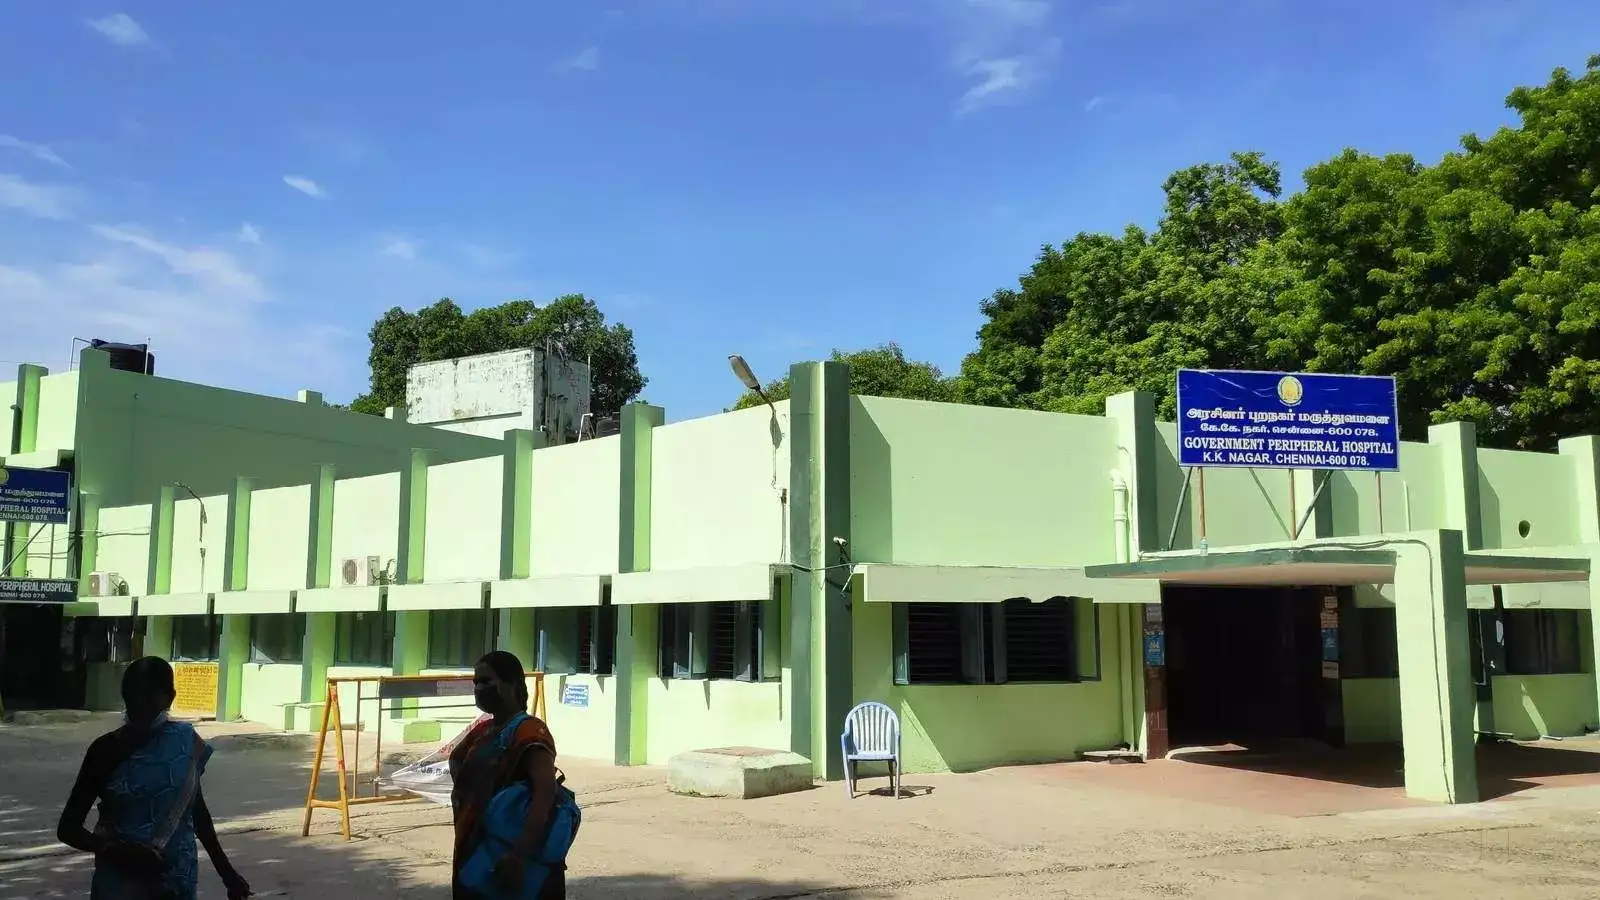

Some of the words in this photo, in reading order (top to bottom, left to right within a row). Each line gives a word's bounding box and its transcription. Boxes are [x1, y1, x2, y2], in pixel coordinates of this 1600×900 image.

[1186, 407, 1246, 421] அரசினர்
[1248, 408, 1296, 423] புறநகர்
[1298, 409, 1390, 426] மருத்துவமனை
[1200, 422, 1241, 432] கே.கே.
[1272, 425, 1352, 436] சென்னை-600
[1354, 428, 1379, 437] 078.
[1184, 436, 1265, 451] GOVERNMENT
[1267, 438, 1340, 453] PERIPHERAL
[1341, 441, 1394, 454] HOSPITAL
[1203, 451, 1226, 462] K.K.
[1228, 452, 1273, 464] NAGAR,
[1275, 453, 1348, 466] CHENNAI-600
[1349, 455, 1370, 466] 078.
[31, 506, 65, 516] HOSPITAL
[41, 582, 73, 594] HOSPITAL
